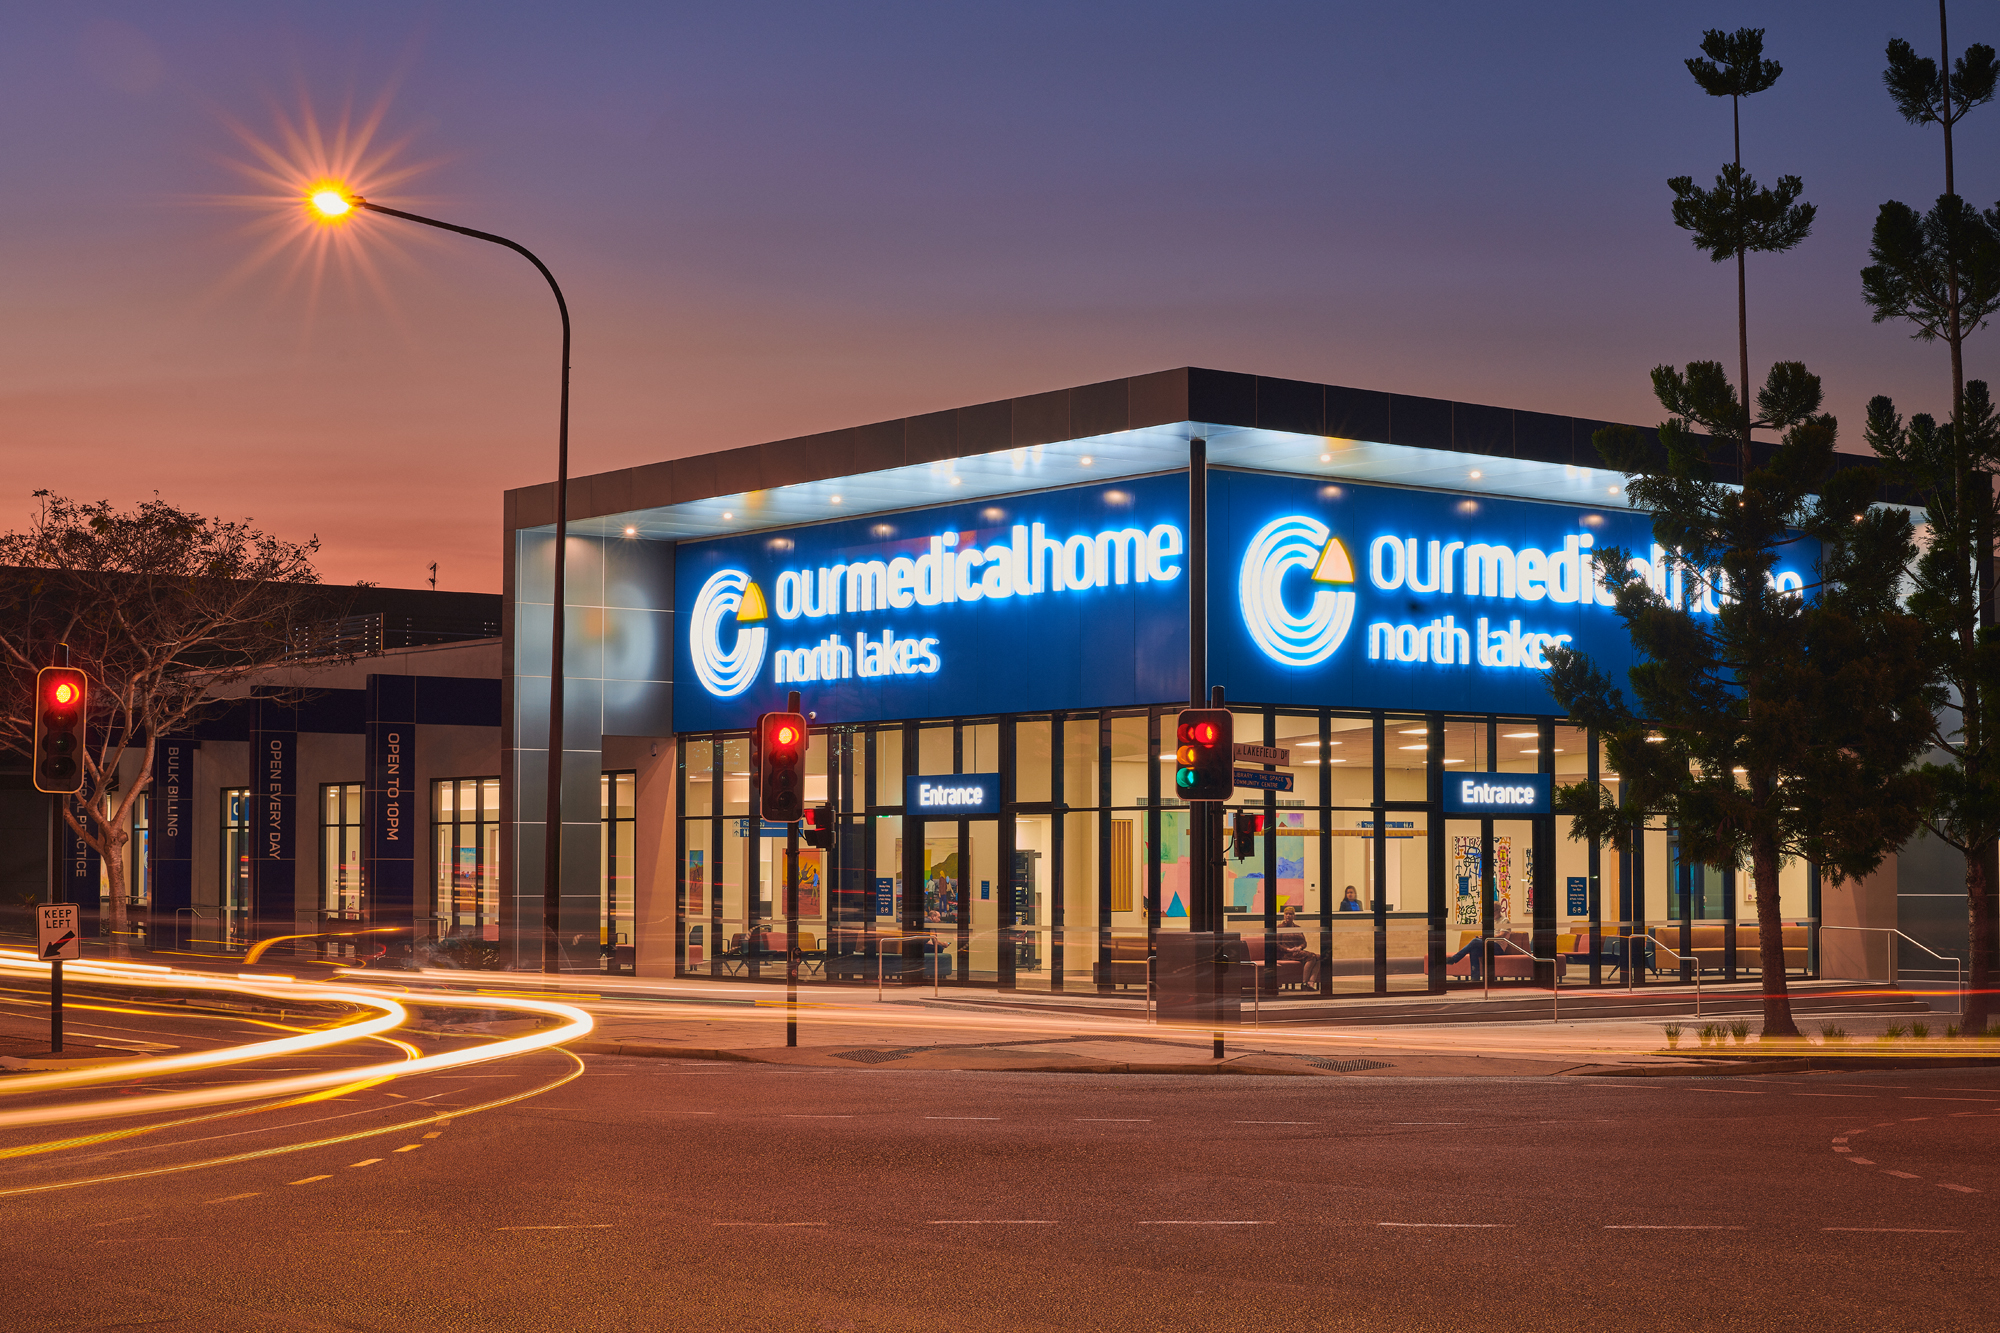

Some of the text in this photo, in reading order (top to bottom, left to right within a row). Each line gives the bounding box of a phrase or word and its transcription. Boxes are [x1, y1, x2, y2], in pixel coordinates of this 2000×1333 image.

[775, 522, 1183, 620] ourmedicalhome
[774, 629, 940, 683] north lakes
[1368, 615, 1470, 665] north
[1243, 745, 1277, 759] LAKEFIELD
[167, 747, 180, 837] BULK BILLING
[269, 740, 282, 860] OPEN EVERY DAY
[386, 733, 400, 841] OPEN TO 10PM
[920, 784, 983, 806] Entrance
[1462, 780, 1534, 804] Entrance
[44, 909, 72, 918] KEEP
[46, 920, 71, 928] LEFT
